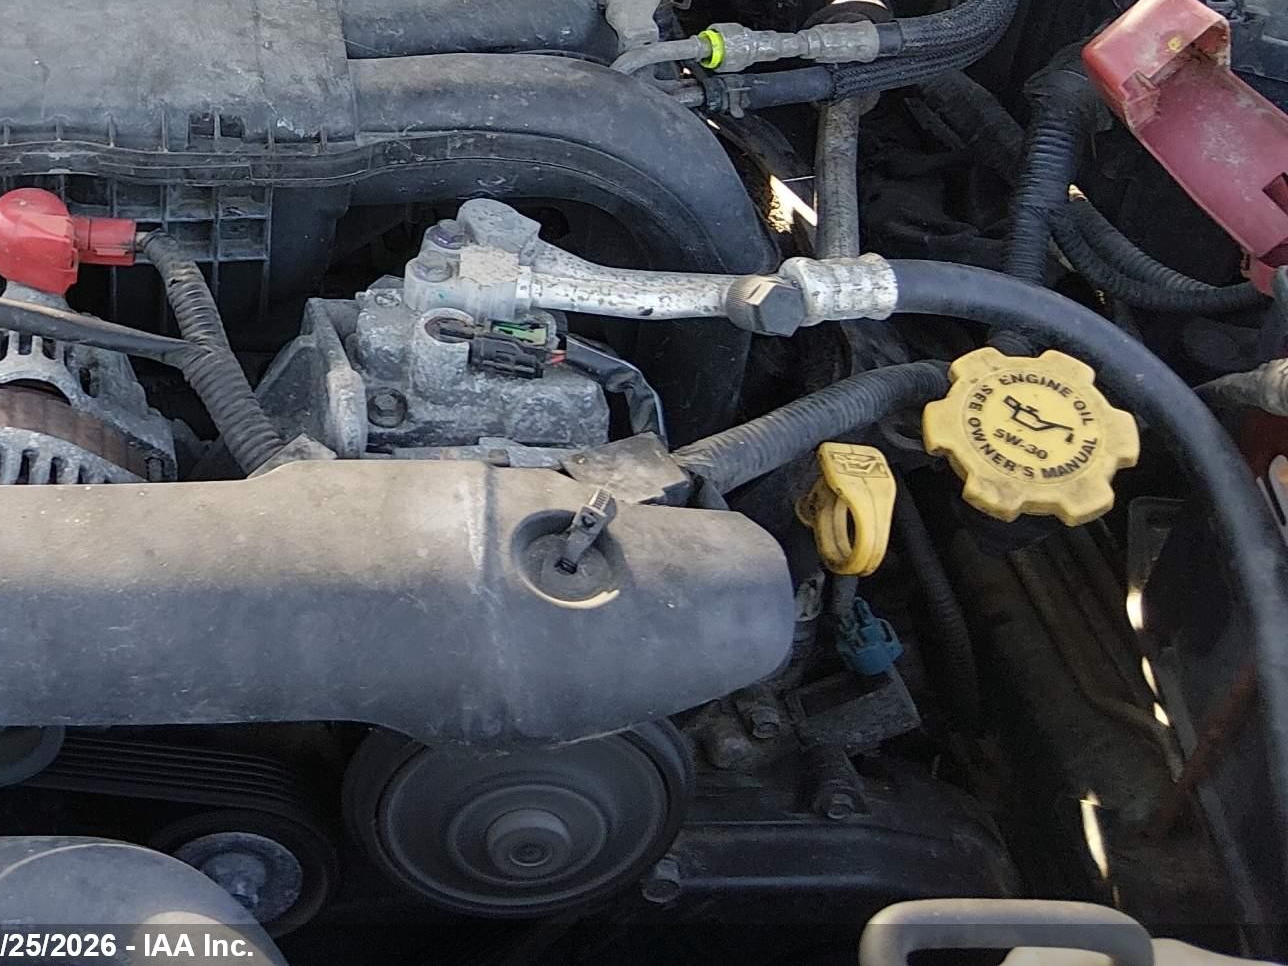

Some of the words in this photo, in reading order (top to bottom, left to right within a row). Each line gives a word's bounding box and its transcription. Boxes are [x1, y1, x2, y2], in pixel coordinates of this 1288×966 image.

[968, 384, 993, 412] SEE
[999, 373, 1073, 399] ENGINE
[1073, 399, 1096, 427] OIL
[967, 416, 1035, 478] OWNER'S
[1041, 436, 1098, 479] MANUAL
